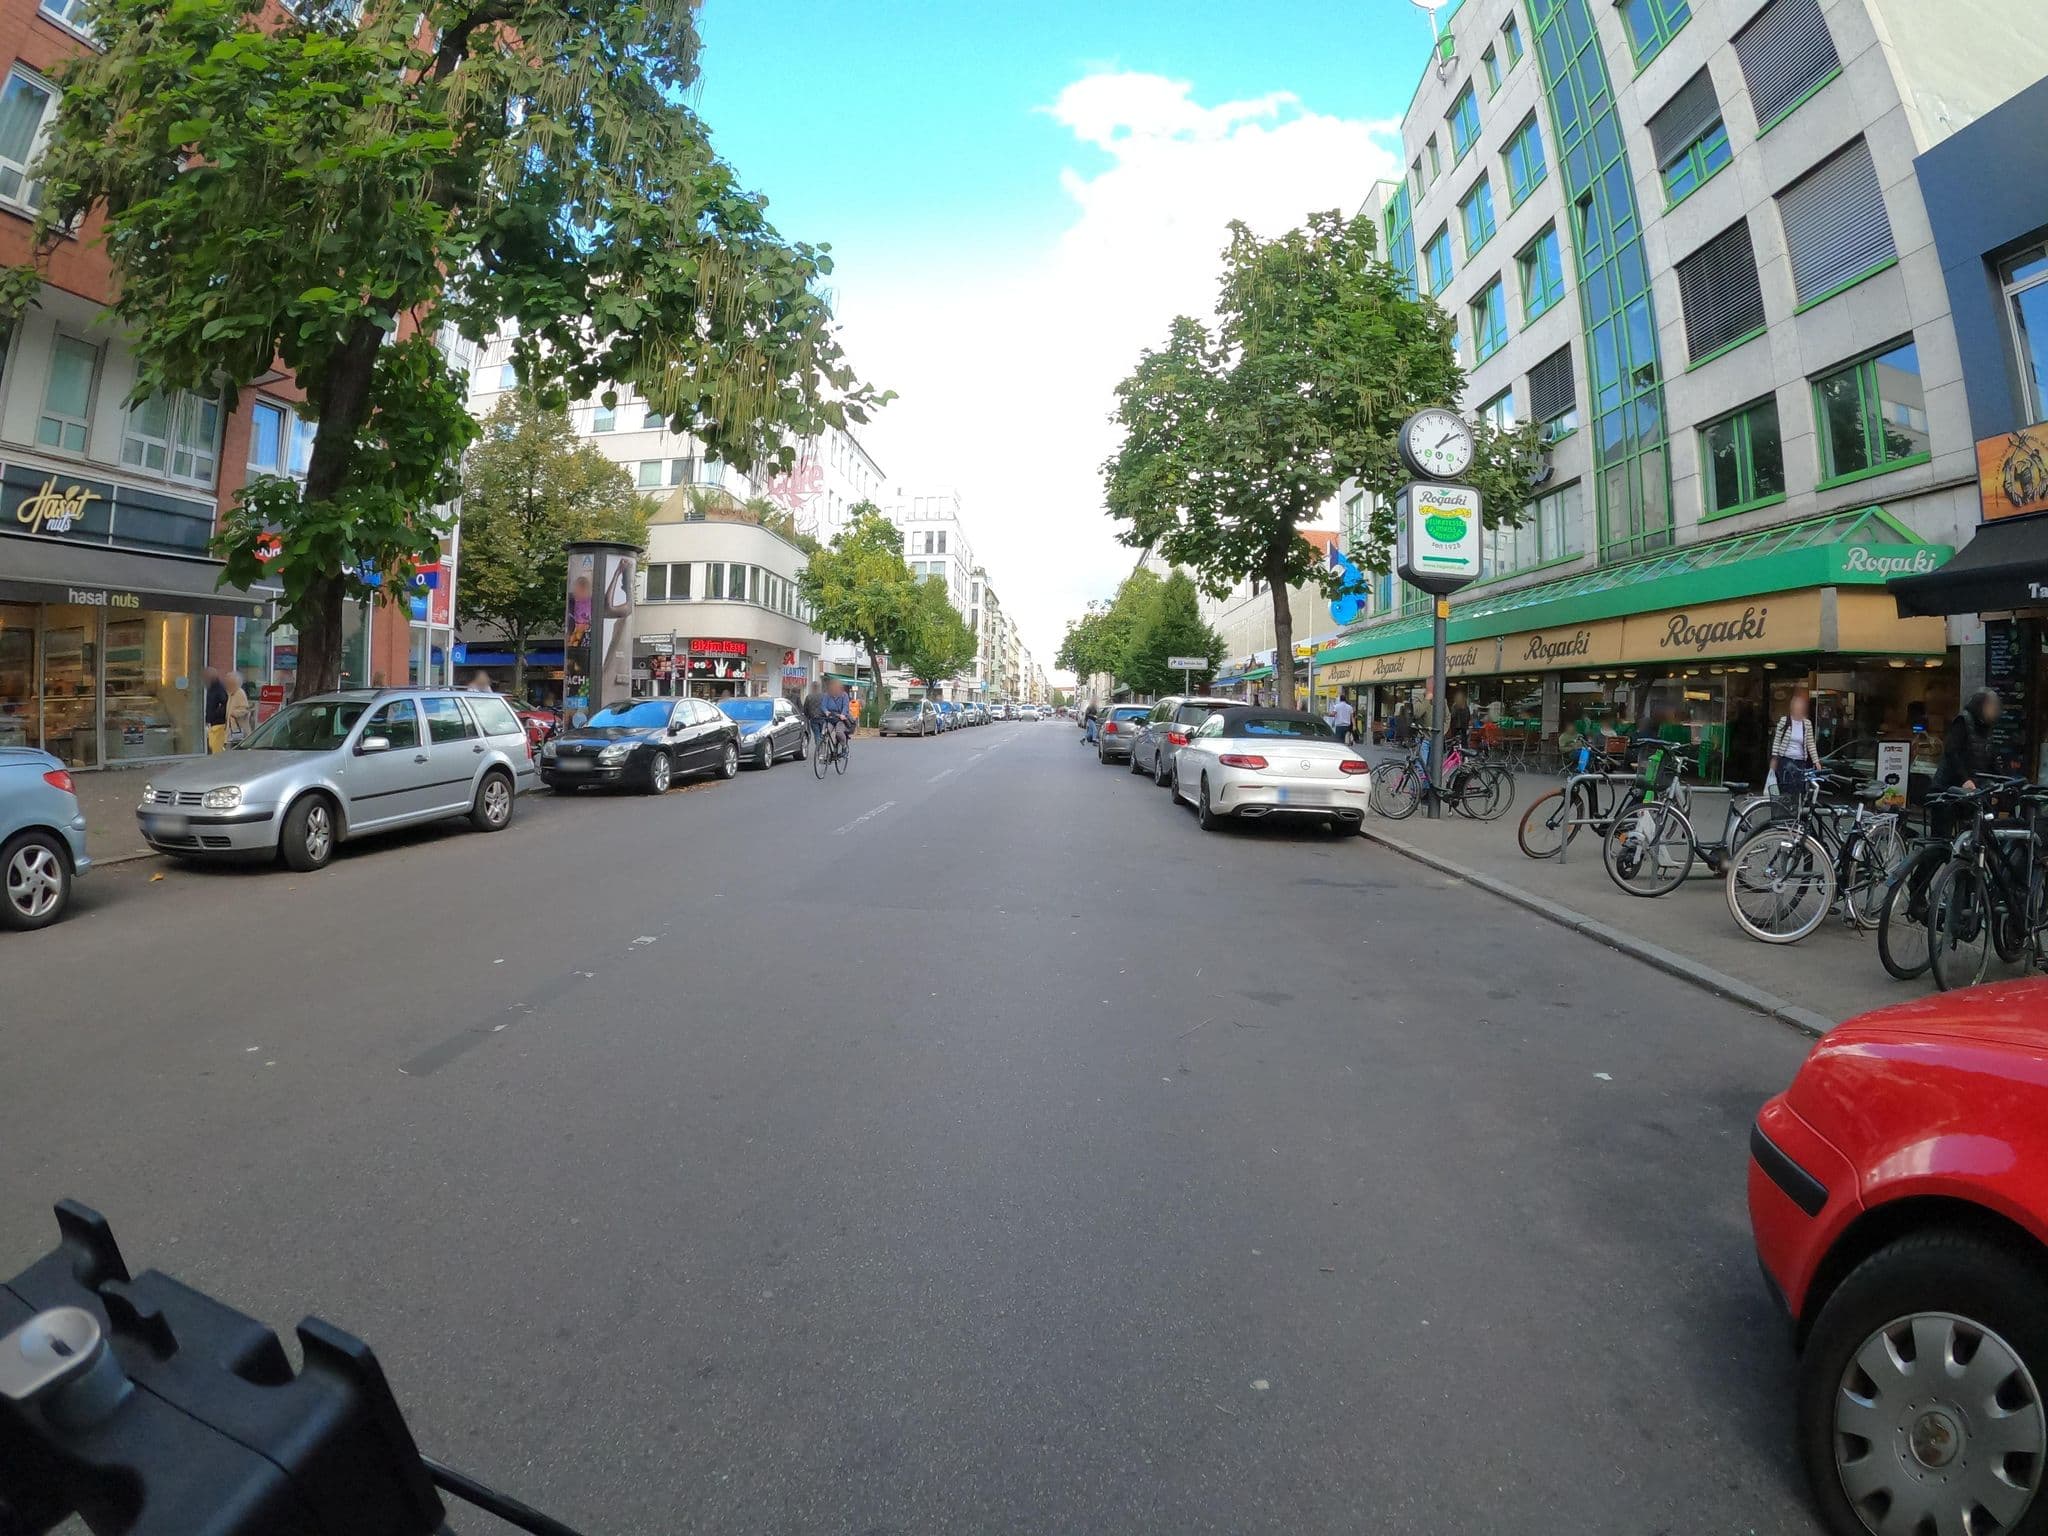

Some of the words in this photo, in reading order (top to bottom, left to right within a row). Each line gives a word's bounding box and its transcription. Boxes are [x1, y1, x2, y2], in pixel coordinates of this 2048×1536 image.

[17, 475, 102, 534] Hasat
[1420, 490, 1467, 506] Rogacki
[46, 511, 72, 532] nuts
[1842, 547, 1937, 577] Rogacki
[69, 588, 108, 606] hasat
[111, 593, 140, 608] nuts
[1660, 607, 1768, 652] Rogacki
[1444, 647, 1478, 668] ogacki
[1524, 630, 1591, 664] Rogacki
[1373, 655, 1406, 680] Rogacki
